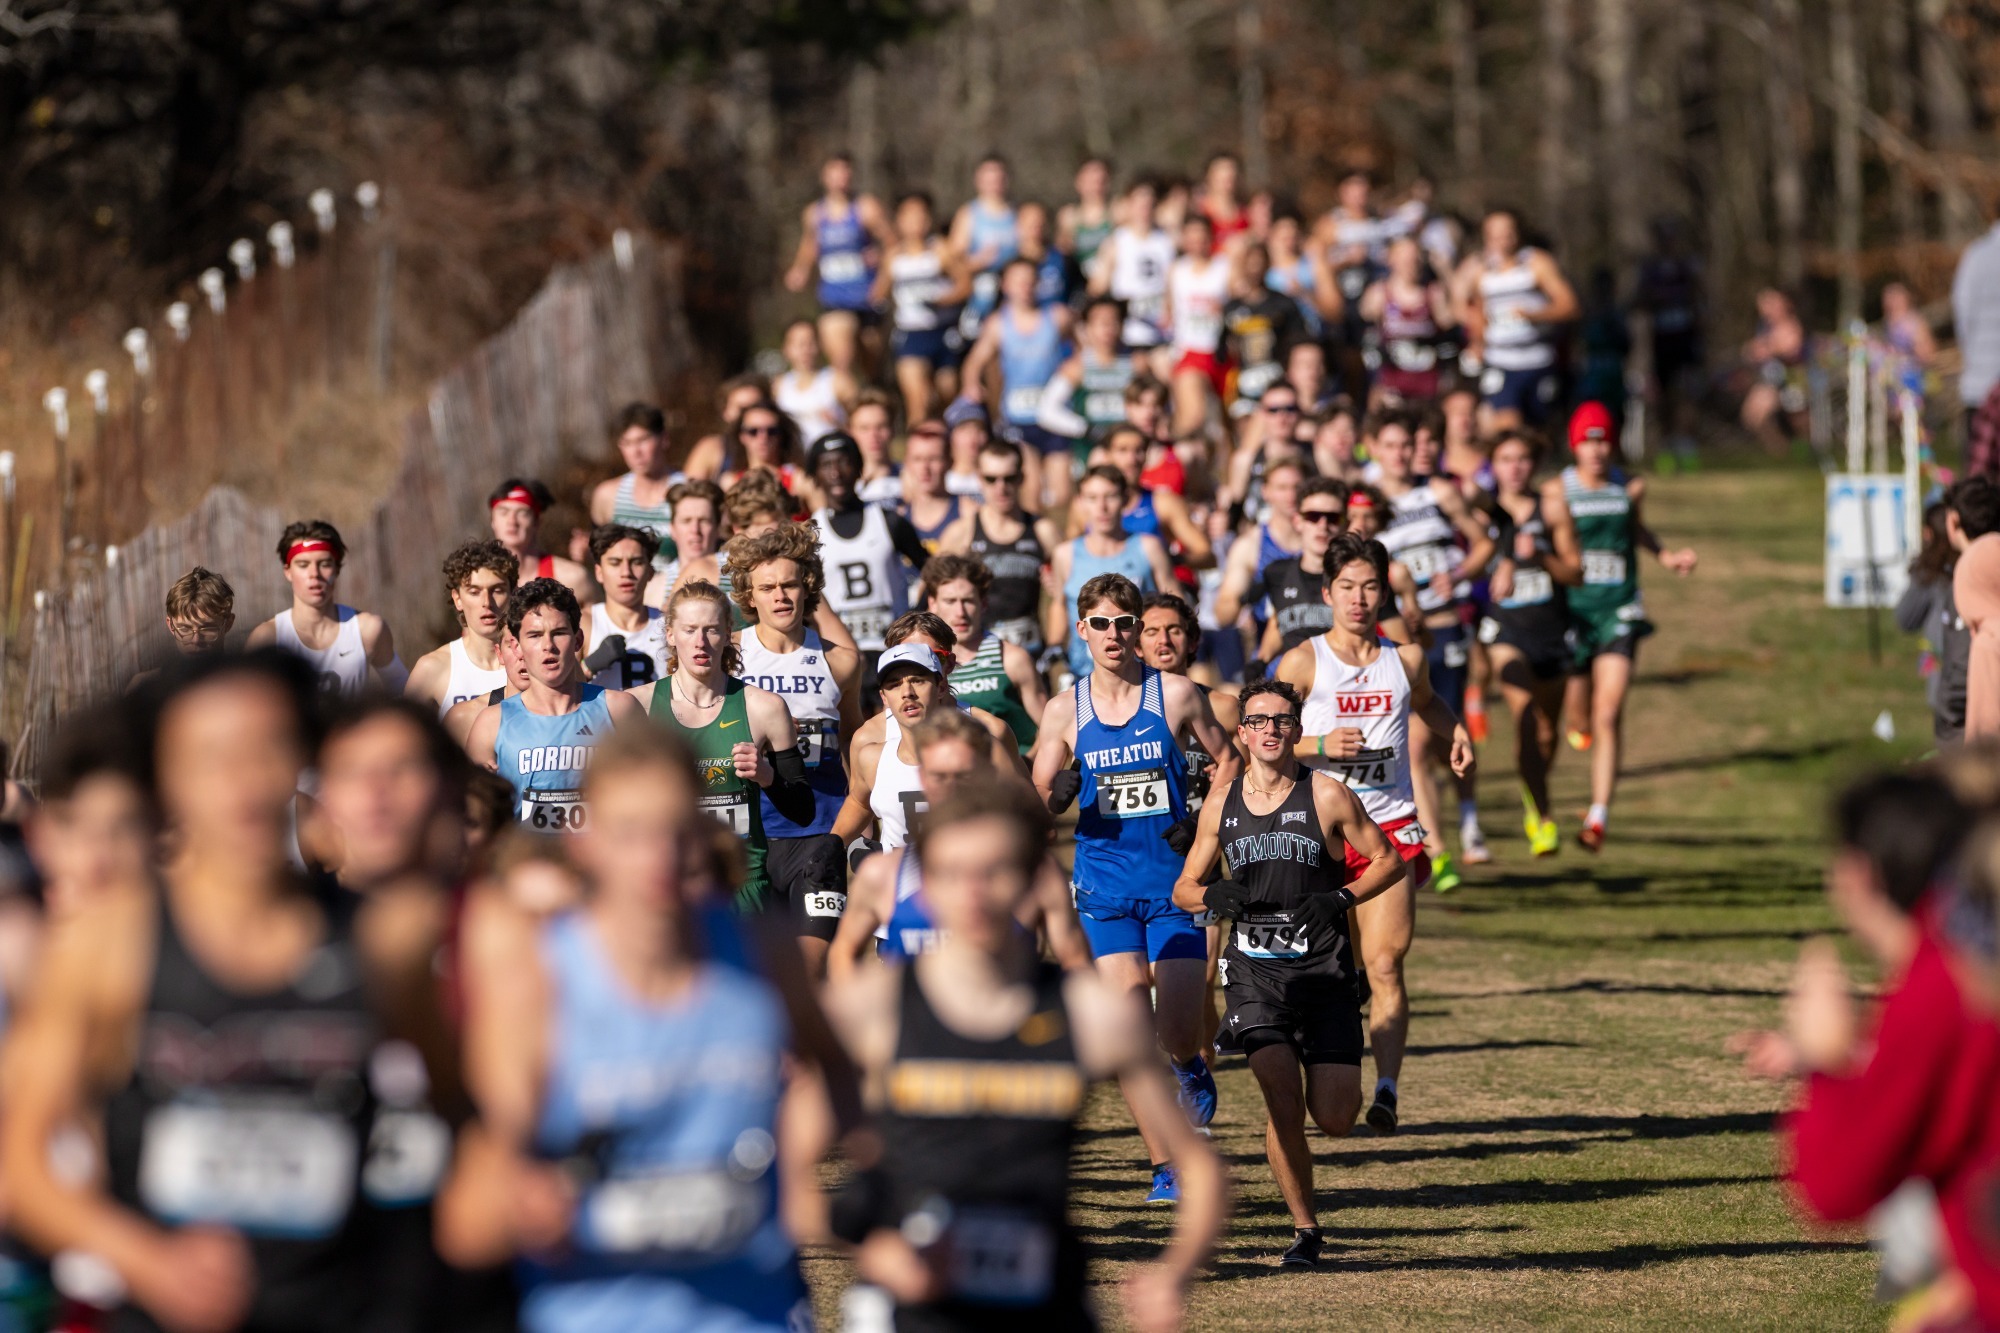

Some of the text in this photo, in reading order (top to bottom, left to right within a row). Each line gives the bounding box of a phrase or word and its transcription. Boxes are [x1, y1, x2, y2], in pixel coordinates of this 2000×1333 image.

[837, 562, 873, 600] B
[1336, 695, 1393, 713] WPI
[1083, 741, 1163, 769] WHEATON
[1102, 775, 1141, 784] CHAMPIONSHIPS
[1340, 763, 1386, 785] 774
[1108, 784, 1158, 811] 756
[532, 804, 587, 830] 630
[814, 897, 845, 911] 563
[1247, 926, 1296, 950] 679
